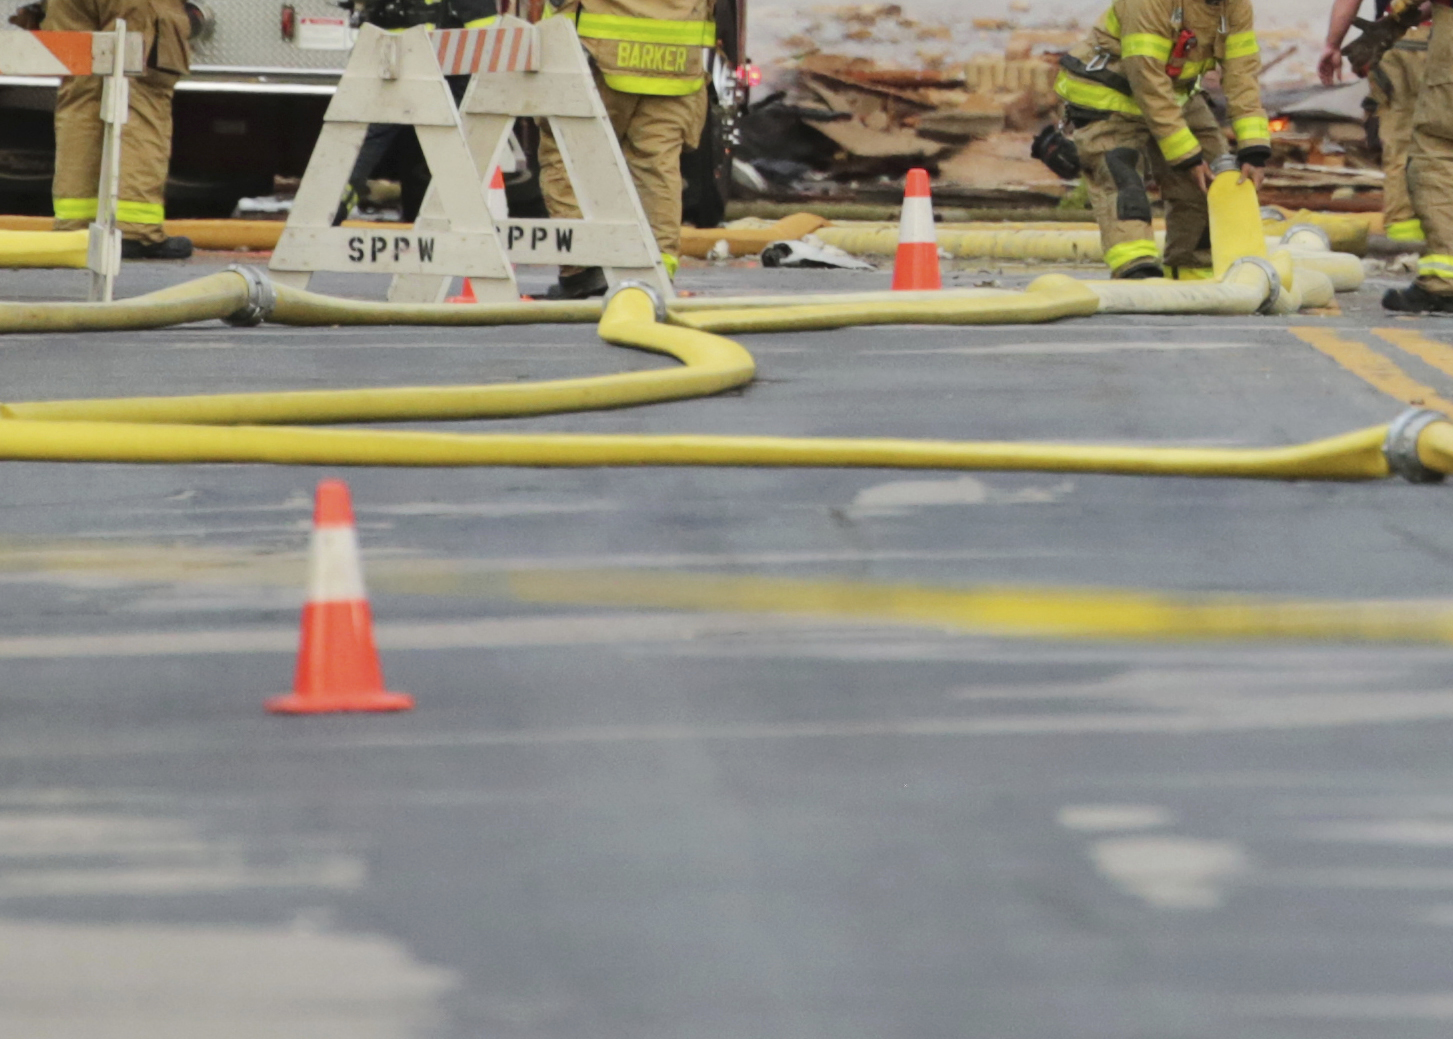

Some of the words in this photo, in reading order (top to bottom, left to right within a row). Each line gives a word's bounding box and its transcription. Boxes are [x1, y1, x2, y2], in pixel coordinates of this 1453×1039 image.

[617, 41, 688, 72] BARKER
[347, 236, 436, 262] SPPW
[497, 225, 574, 253] PPW
